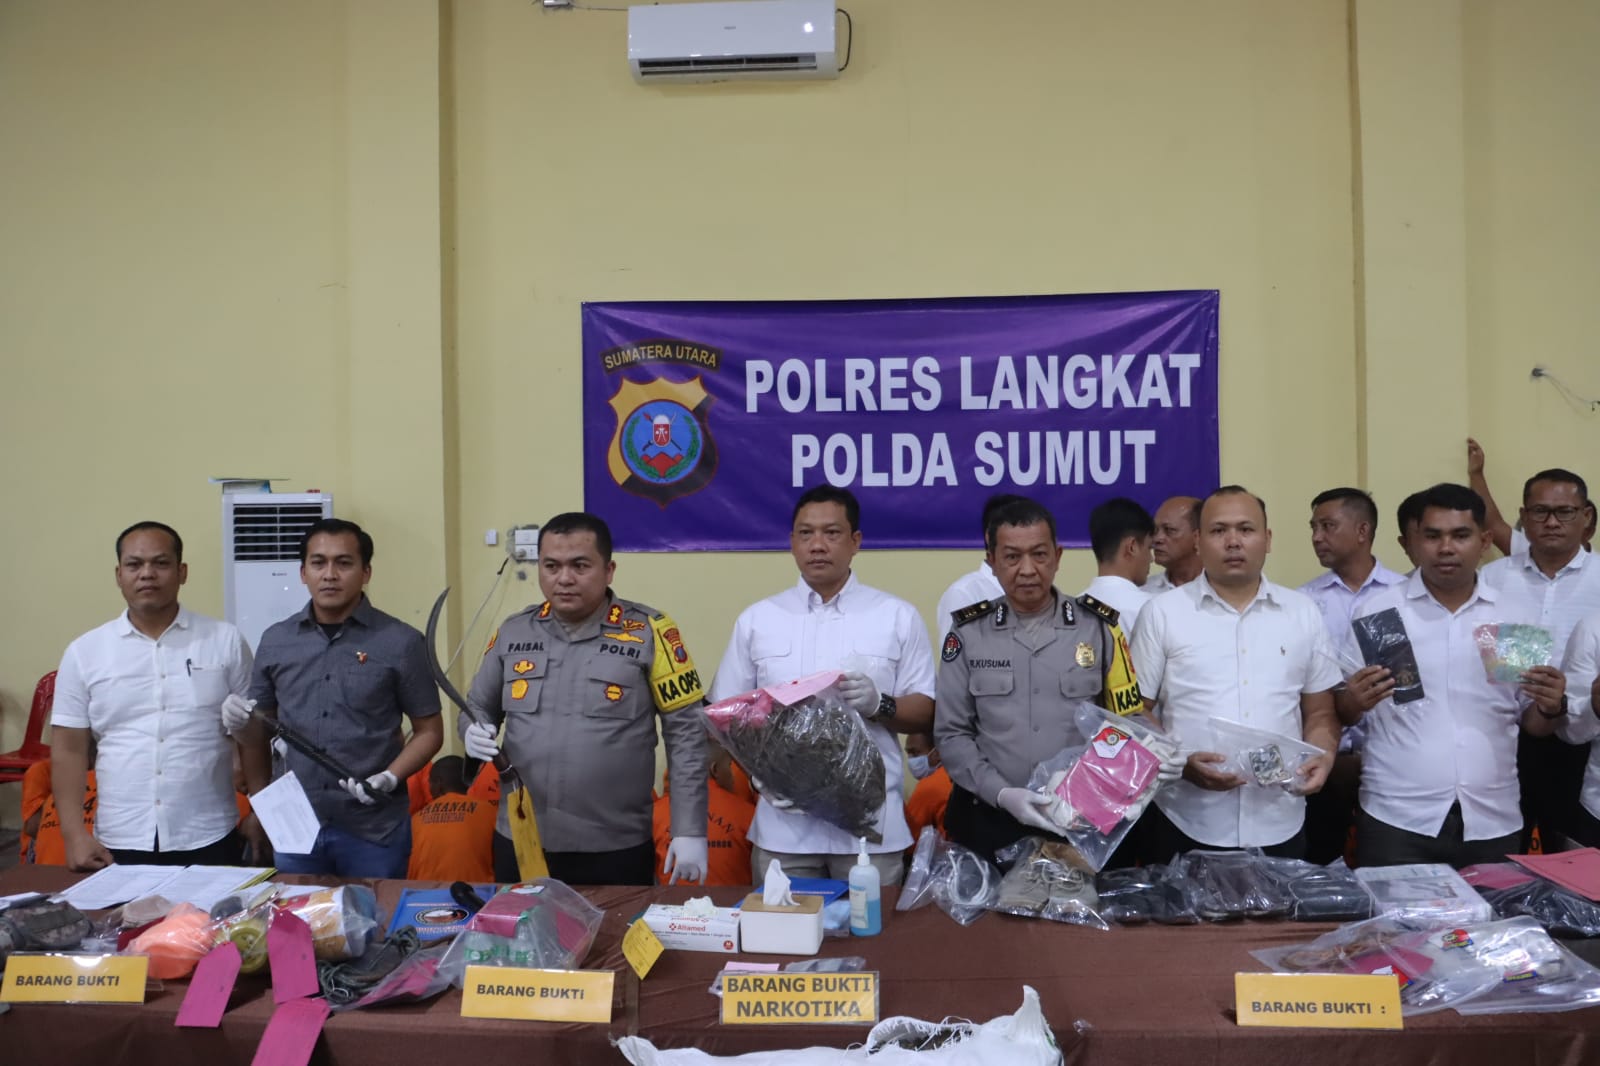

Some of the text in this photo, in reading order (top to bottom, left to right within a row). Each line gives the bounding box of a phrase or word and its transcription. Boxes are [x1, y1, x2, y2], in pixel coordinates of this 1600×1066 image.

[604, 345, 717, 369] SUMATERA UTARA
[745, 354, 1200, 413] POLRES LANGKAT
[791, 430, 1156, 488] POLDA SUMUT
[507, 641, 545, 653] FAISAL
[599, 643, 641, 660] POLRI
[657, 679, 681, 704] KA
[15, 976, 120, 986] BARANG BUKTI
[726, 977, 871, 993] BARANG BUKTI
[477, 984, 536, 998] BARANG
[736, 1000, 862, 1017] NARKOTIKA
[1252, 1001, 1318, 1014] BARANG
[1323, 1002, 1371, 1014] BUKTI
